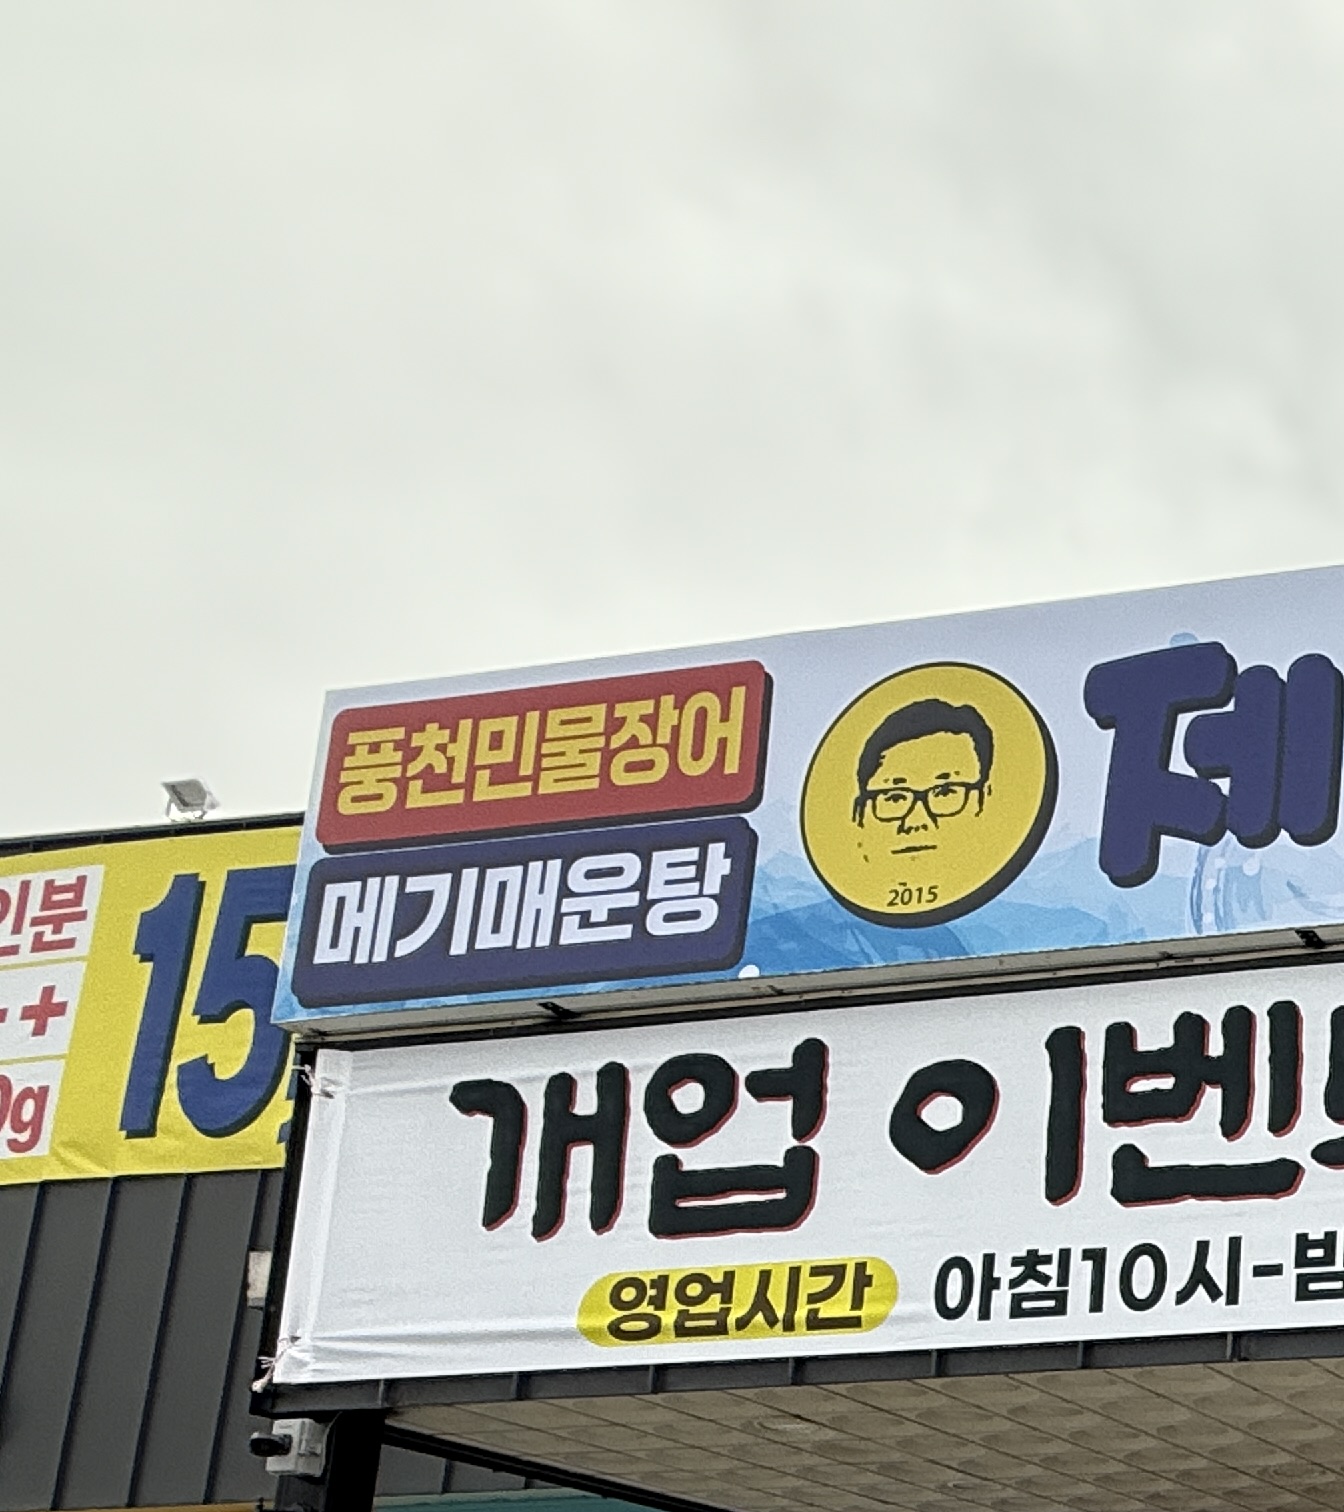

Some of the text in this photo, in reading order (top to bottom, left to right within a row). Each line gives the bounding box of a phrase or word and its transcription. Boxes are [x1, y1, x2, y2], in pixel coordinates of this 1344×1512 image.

[337, 684, 745, 816] 풍천민물장어
[312, 841, 733, 967] 메기매운탕
[886, 884, 940, 908] 2015
[449, 1037, 829, 1243] 개업
[607, 1262, 874, 1341] 영업시간
